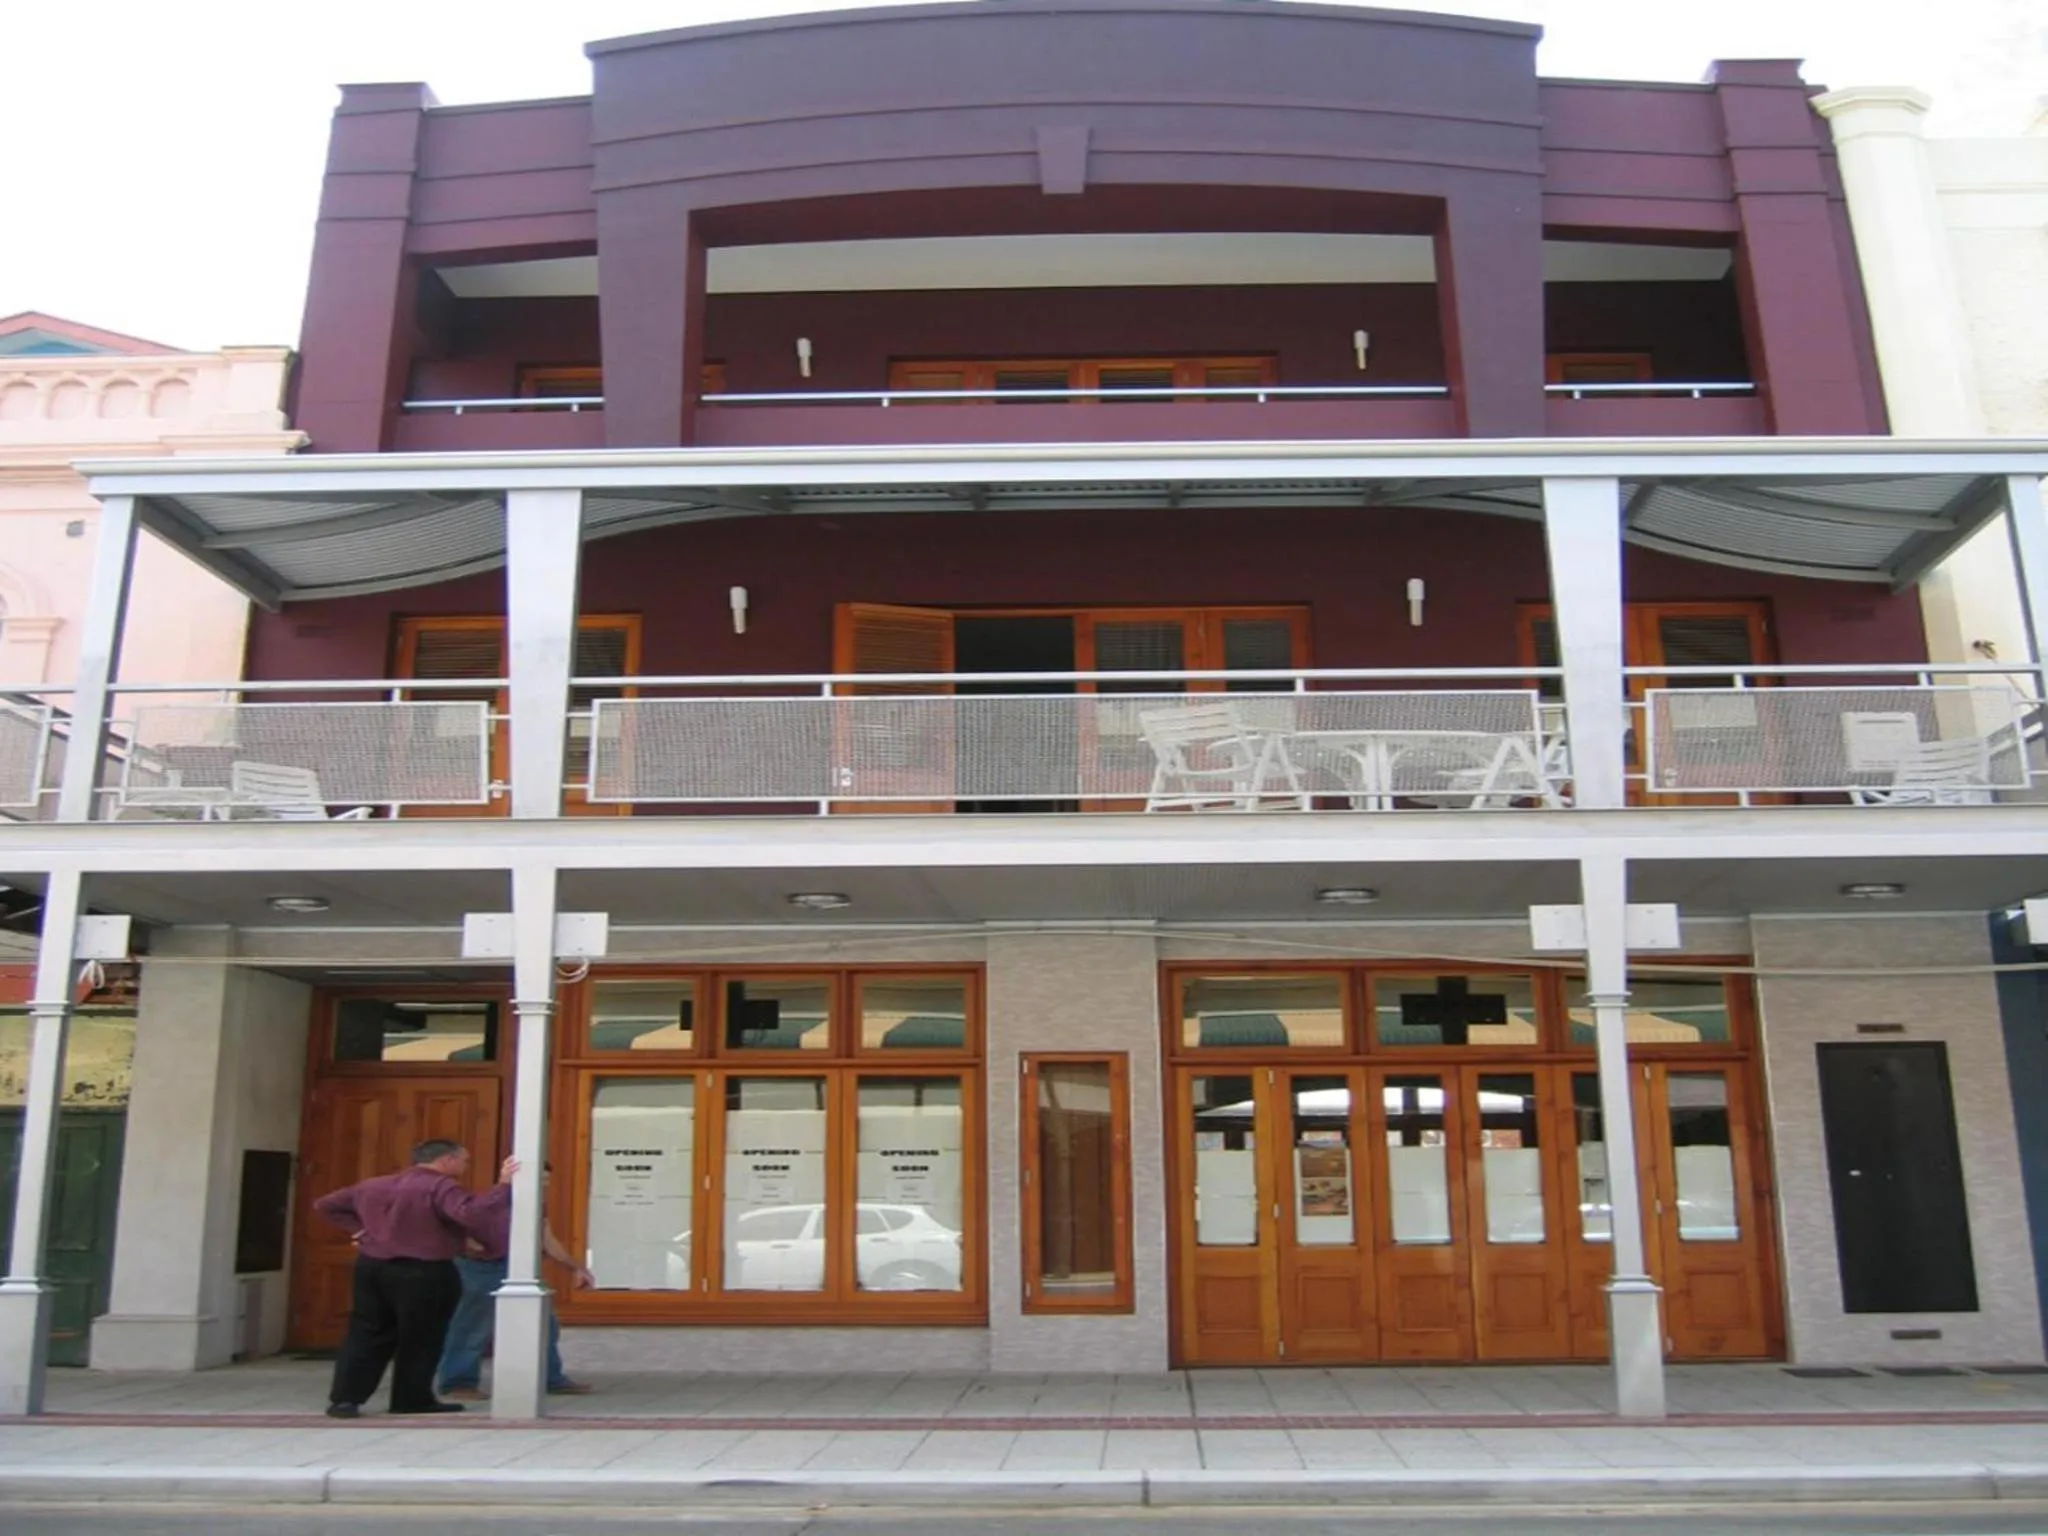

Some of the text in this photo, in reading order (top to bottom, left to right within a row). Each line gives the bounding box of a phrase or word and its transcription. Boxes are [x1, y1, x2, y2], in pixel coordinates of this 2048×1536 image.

[604, 1148, 663, 1157] OPENING
[742, 1148, 801, 1157] OPENING
[880, 1149, 940, 1157] OPENING
